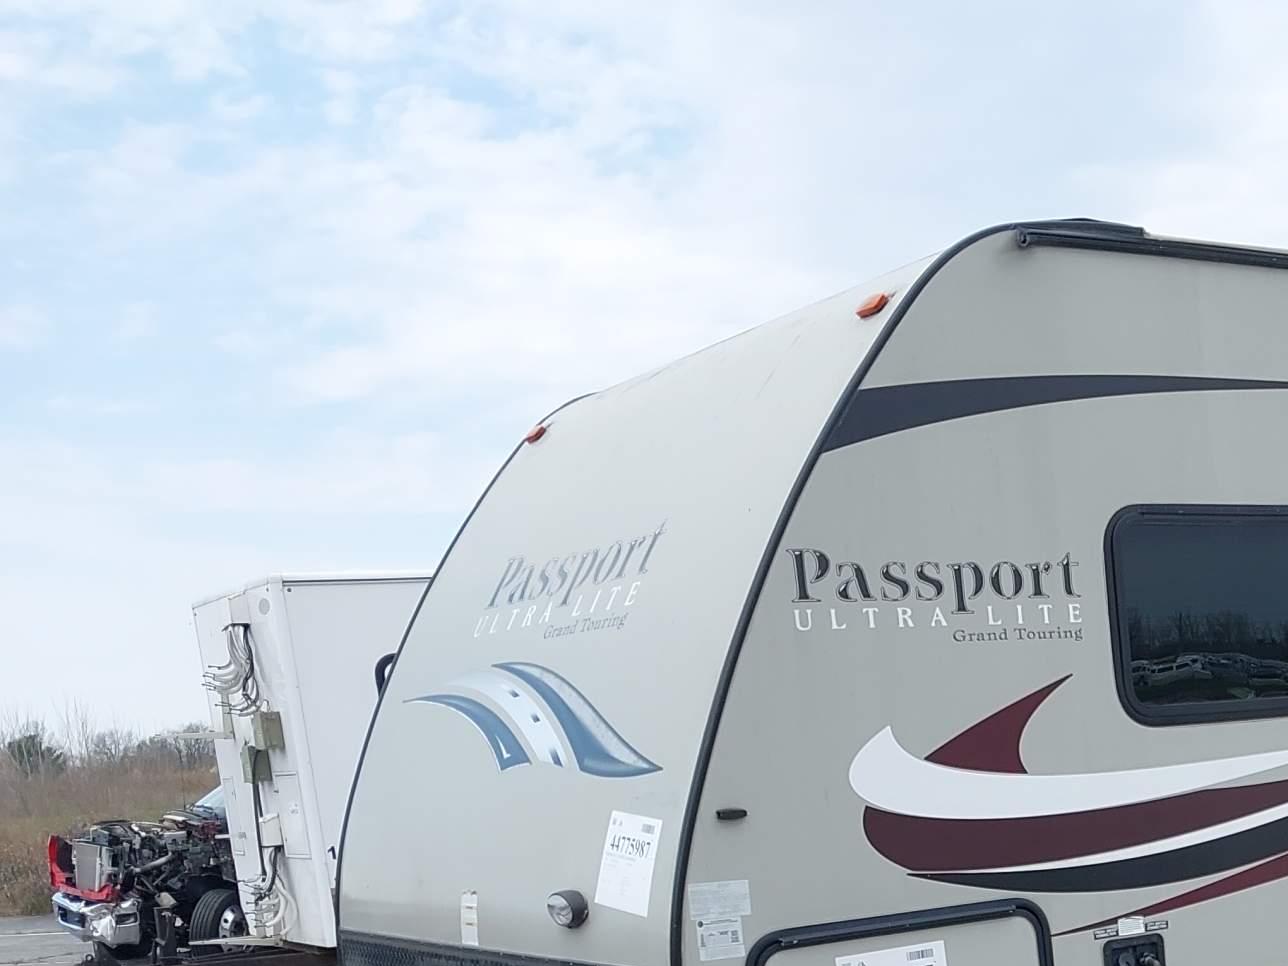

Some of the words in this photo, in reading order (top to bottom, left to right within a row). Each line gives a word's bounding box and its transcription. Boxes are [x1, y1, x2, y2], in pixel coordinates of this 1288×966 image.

[485, 518, 668, 609] Passport
[786, 548, 1081, 614] Passport
[473, 602, 553, 638] ULTRA
[571, 581, 642, 617] LITE
[793, 606, 948, 631] ULTRA
[986, 603, 1083, 626] LITE
[543, 620, 579, 640] Grand
[579, 612, 630, 633] Touring
[953, 628, 1009, 643] Grand
[1013, 626, 1084, 642] Touring
[610, 834, 652, 858] 44775987
